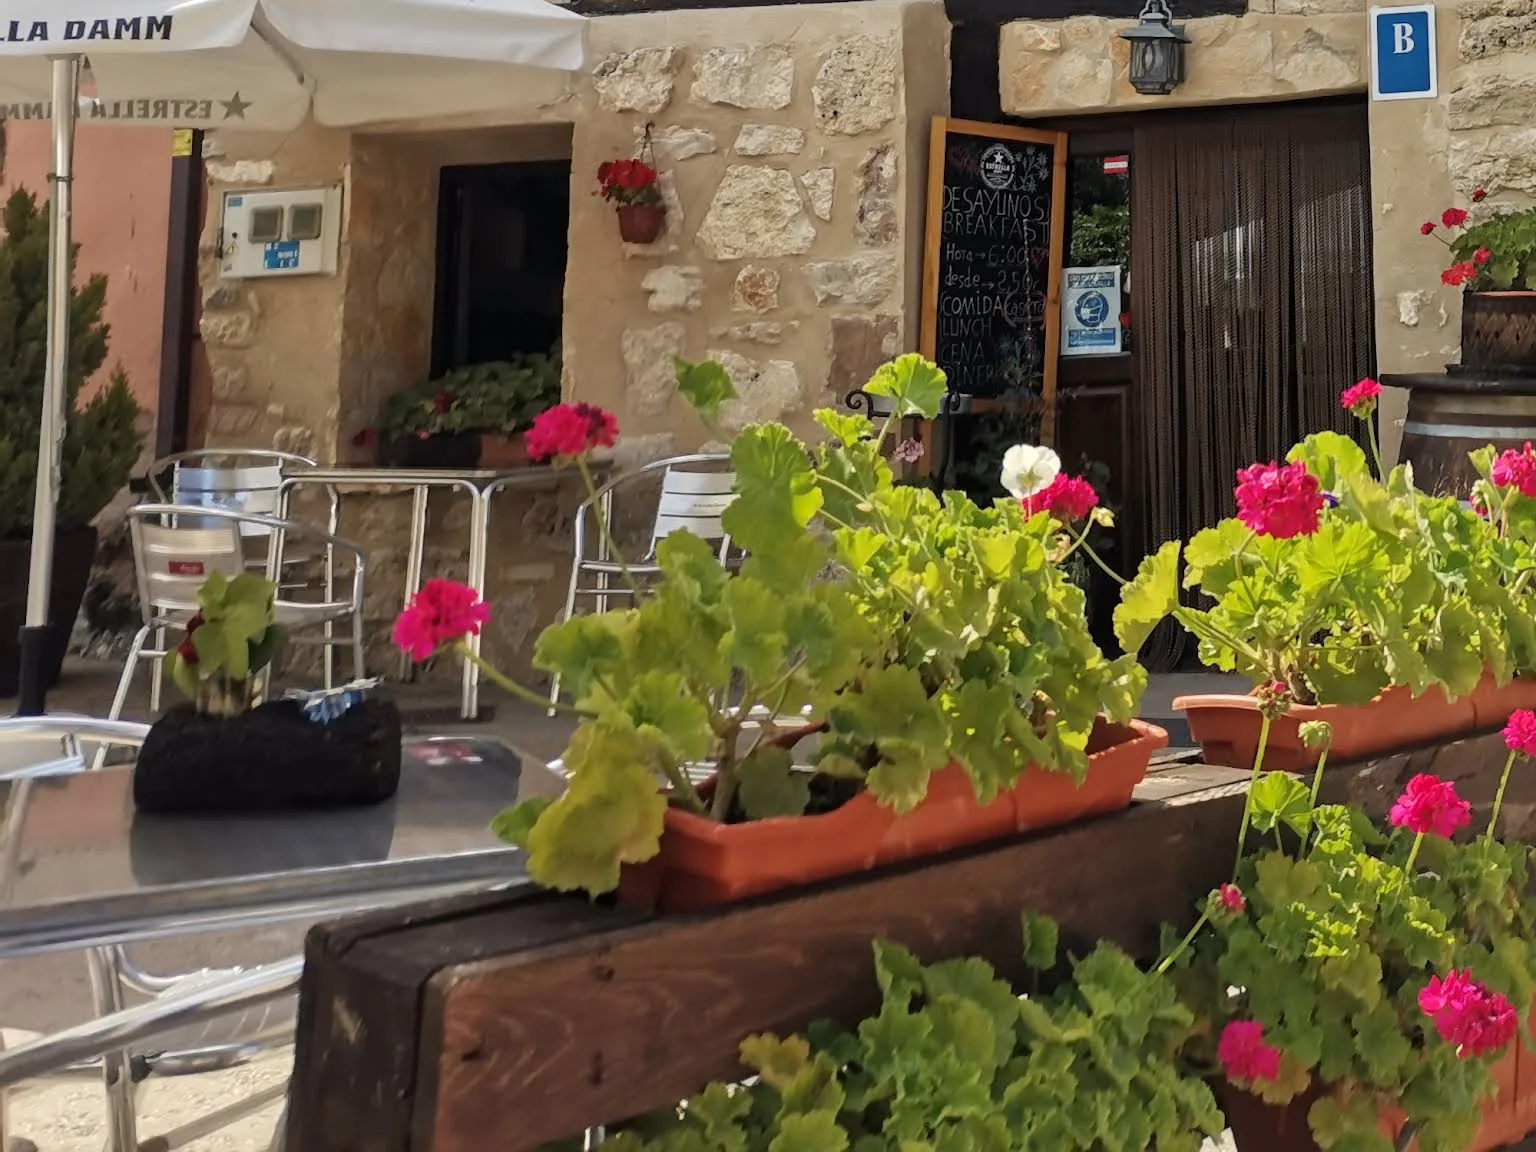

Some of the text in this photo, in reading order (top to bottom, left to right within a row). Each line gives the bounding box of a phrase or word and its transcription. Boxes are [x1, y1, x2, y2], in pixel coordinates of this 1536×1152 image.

[63, 15, 173, 41] DAMM
[1392, 23, 1415, 54] B
[943, 186, 1045, 221] DESAYUNOS
[943, 211, 1048, 245] BREAKFAST
[946, 242, 973, 262] Hora
[945, 265, 981, 288] desde
[943, 318, 992, 337] LUNCH
